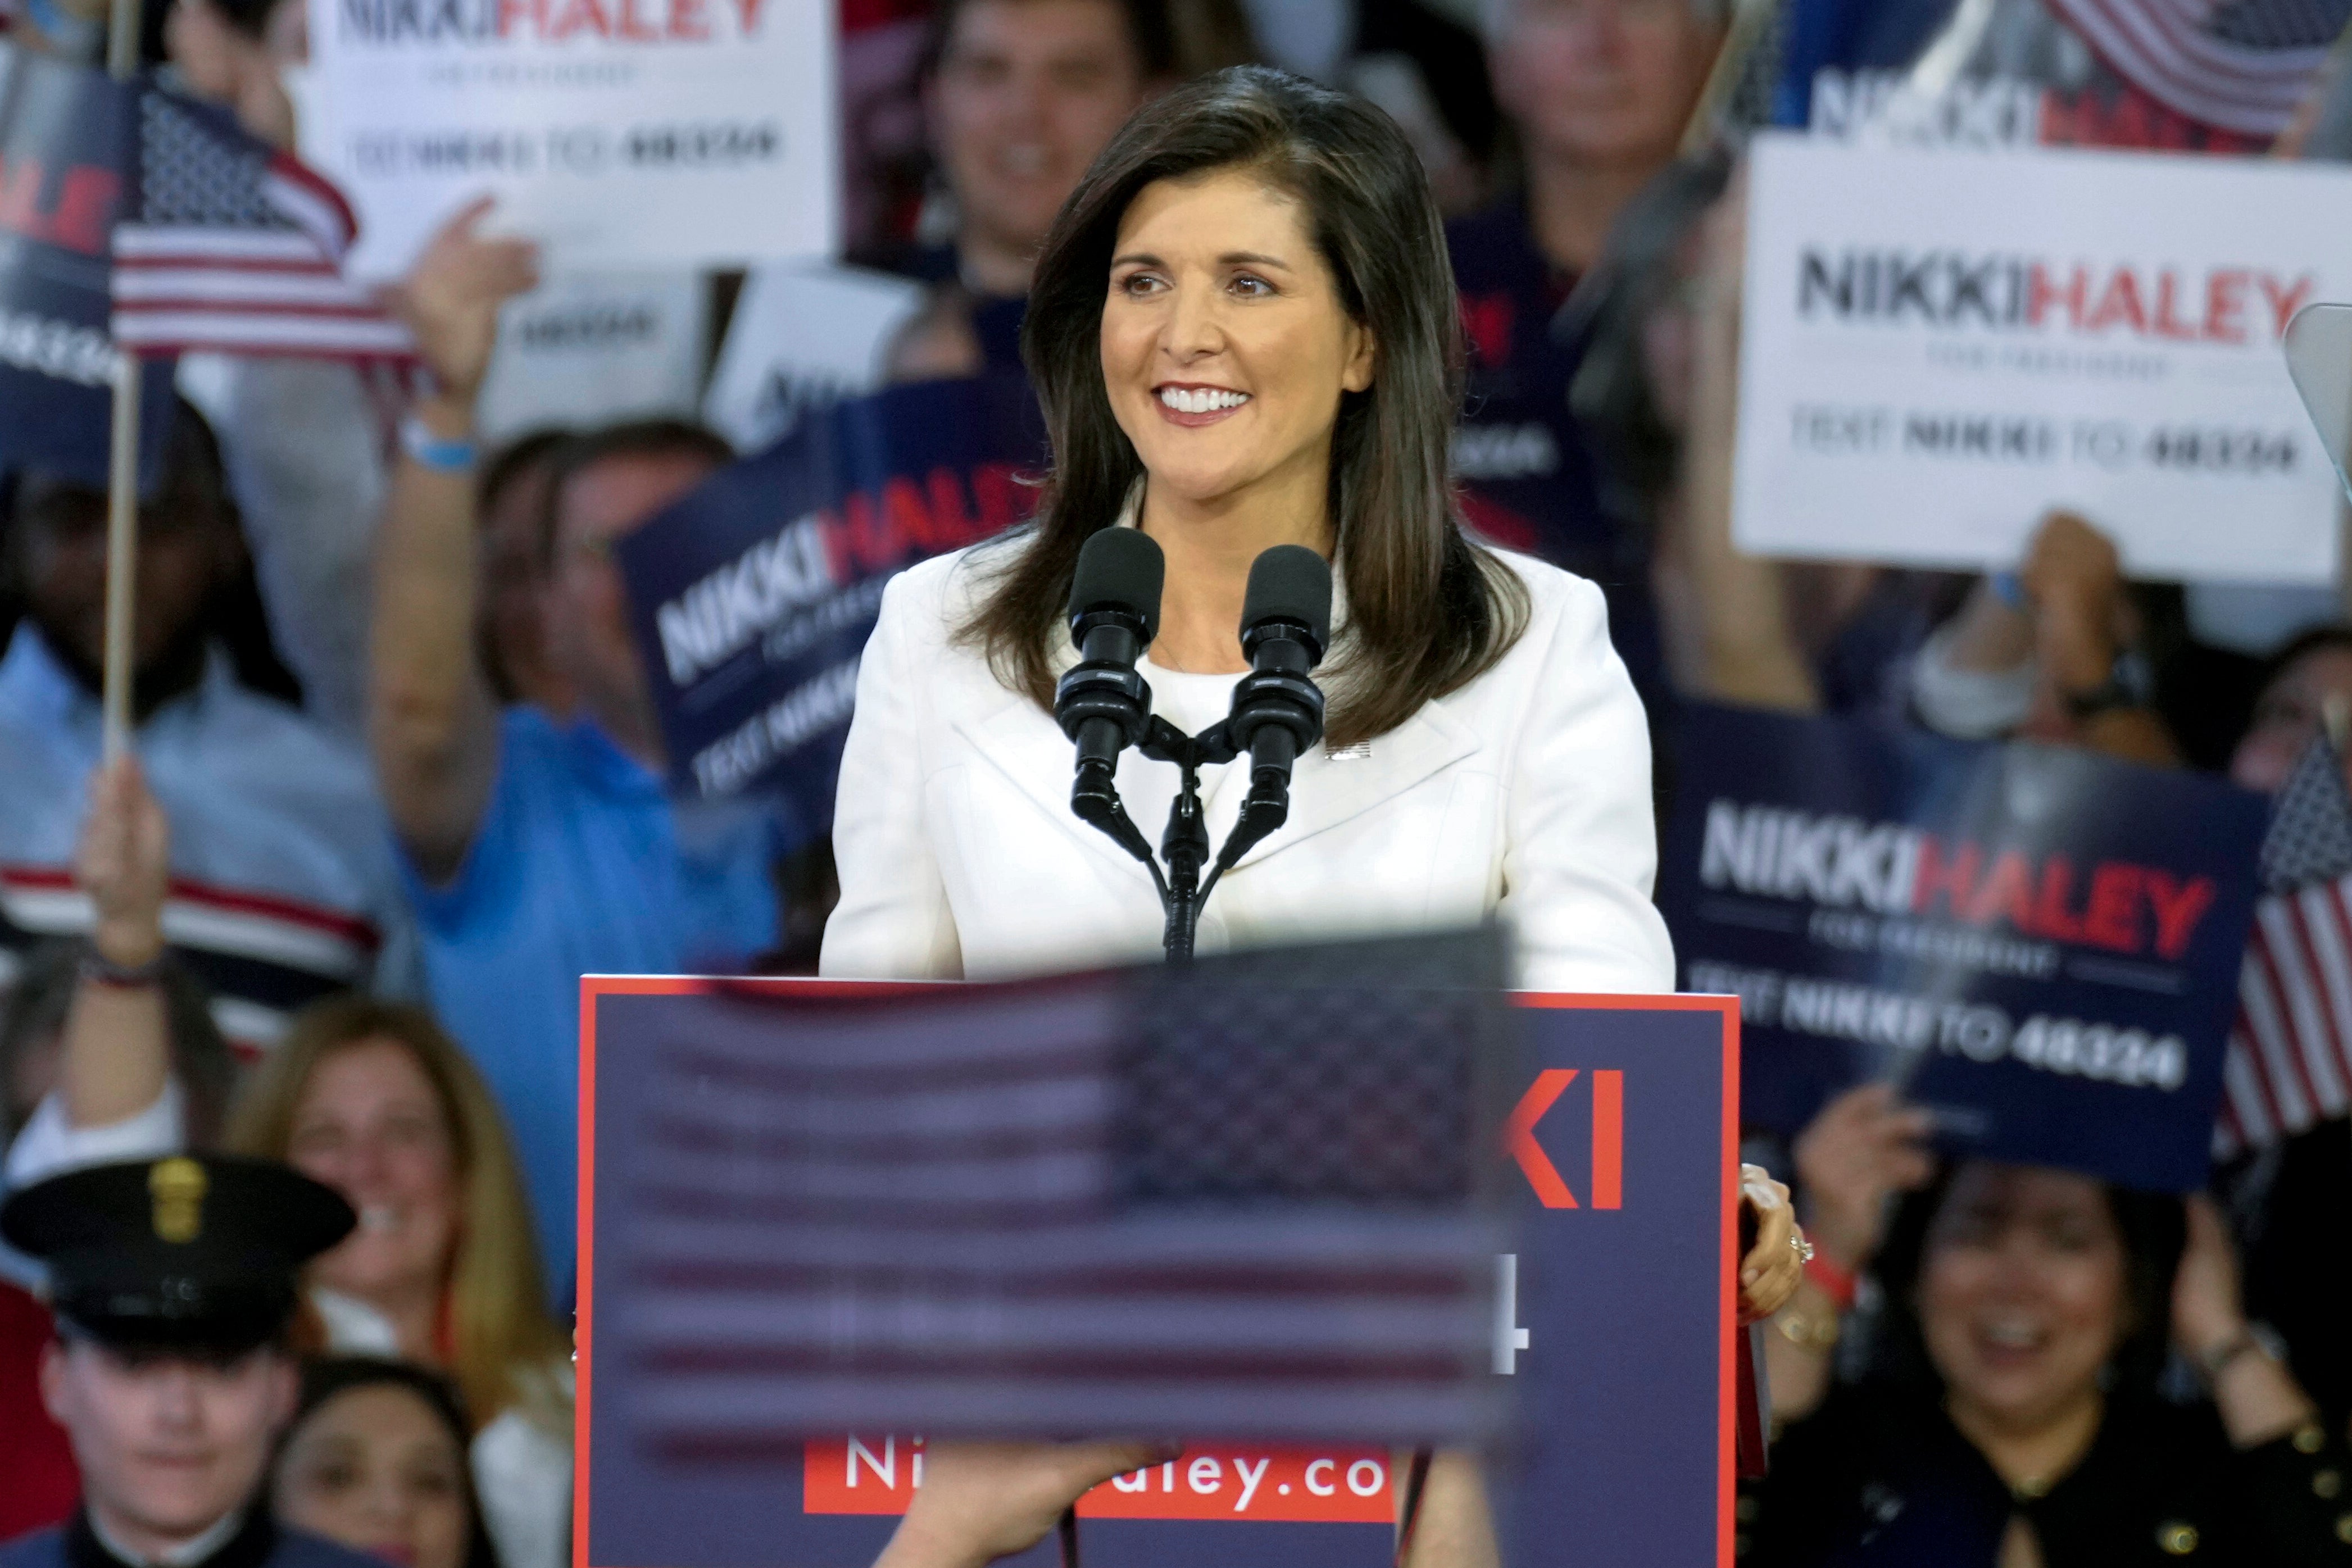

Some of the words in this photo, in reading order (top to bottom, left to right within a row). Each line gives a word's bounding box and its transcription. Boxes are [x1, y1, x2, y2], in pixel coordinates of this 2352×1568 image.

[1796, 246, 2313, 344] NIKKIHALEY
[2070, 420, 2128, 471] TO
[655, 462, 1045, 687] NIKKIHALE
[1699, 798, 2218, 959] NIKKIHALEY
[2014, 1013, 2187, 1092] 48324
